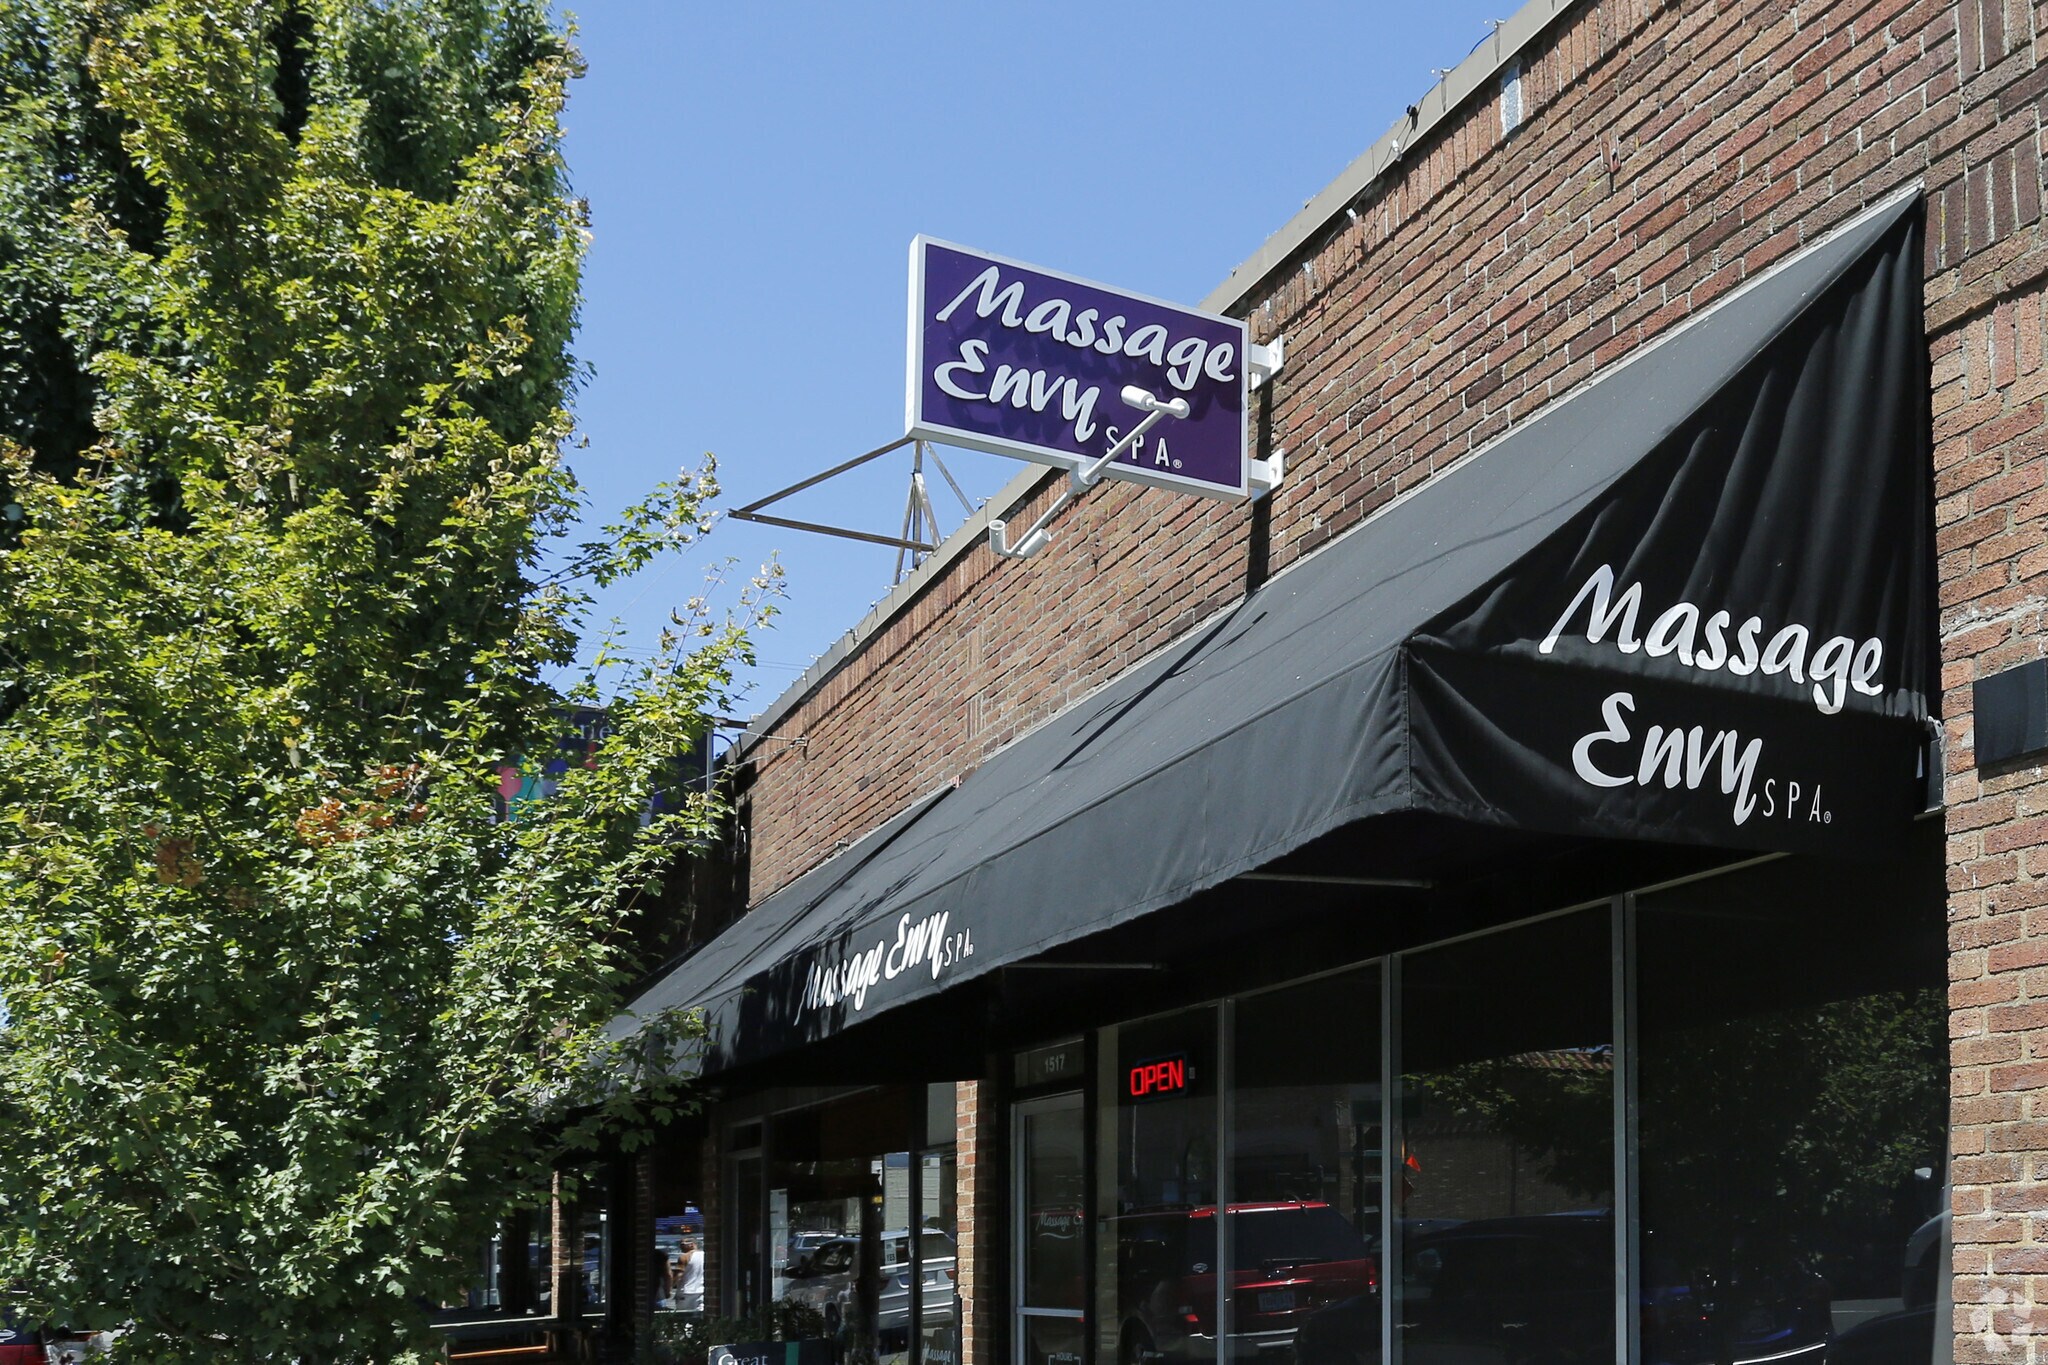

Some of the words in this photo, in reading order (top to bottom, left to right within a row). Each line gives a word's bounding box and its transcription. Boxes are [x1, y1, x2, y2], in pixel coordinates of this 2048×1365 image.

[936, 265, 1235, 391] Massage
[933, 339, 1100, 443] Envy
[1538, 564, 1884, 714] Massage
[1572, 692, 1763, 826] Envy
[794, 940, 884, 1026] Massage
[885, 911, 949, 980] Envy
[1044, 1053, 1066, 1073] 1517
[1130, 1059, 1185, 1097] OPEN
[1036, 1210, 1071, 1232] Massage
[717, 1353, 769, 1365] Great
